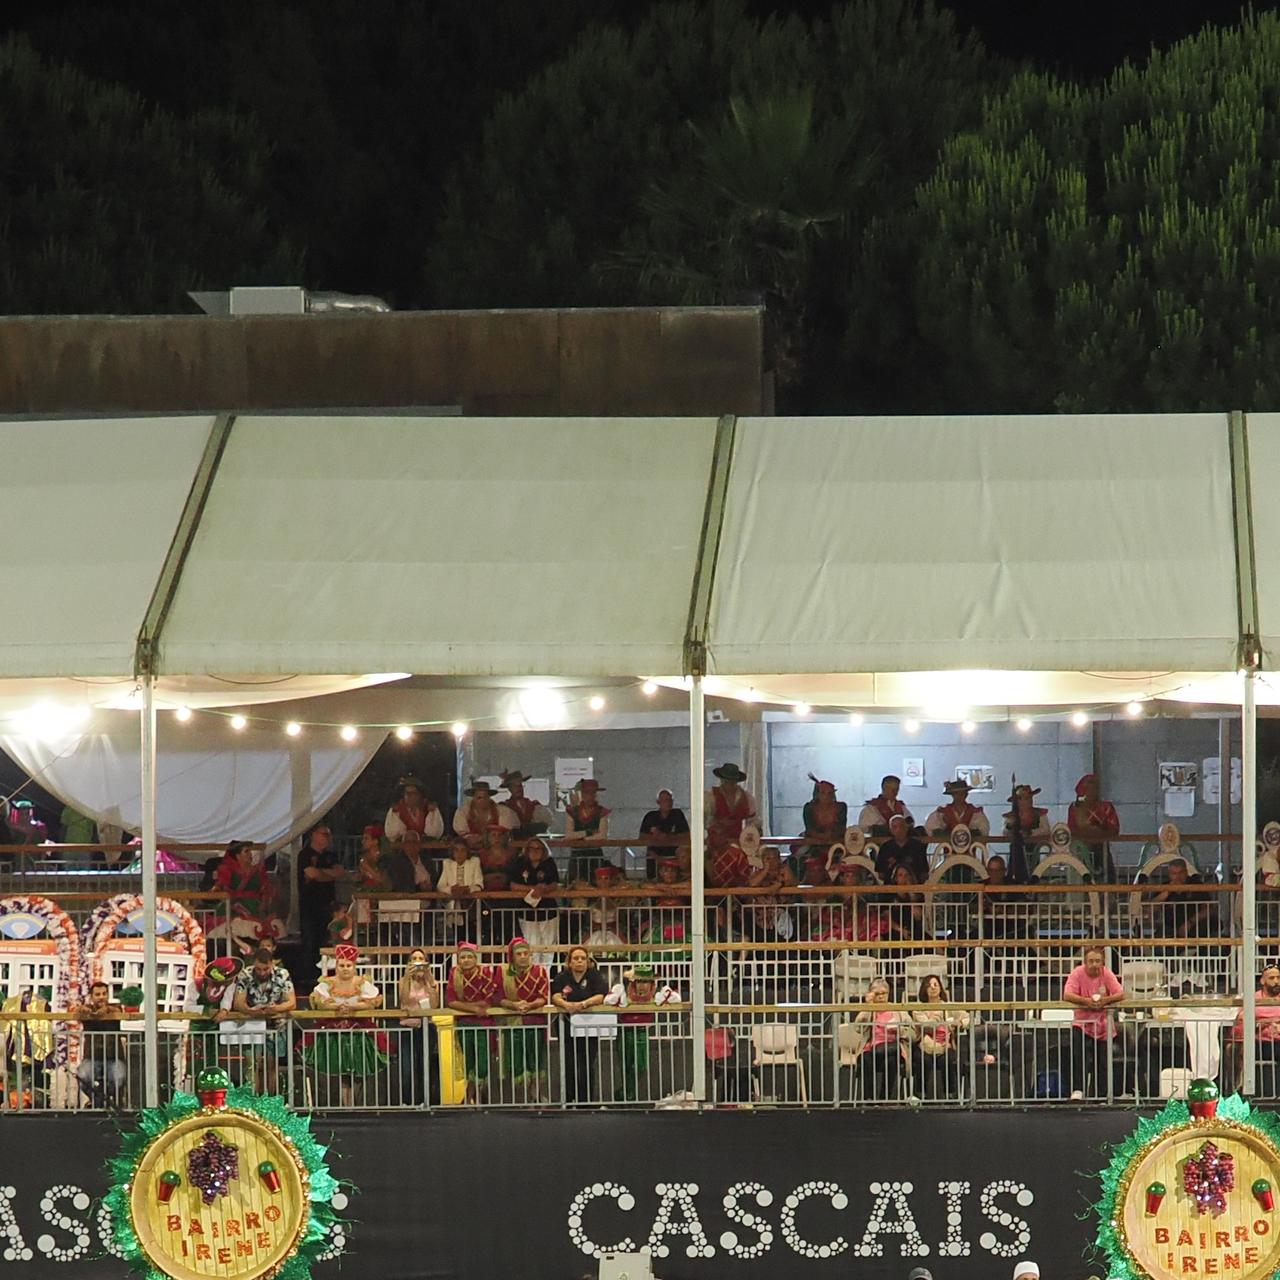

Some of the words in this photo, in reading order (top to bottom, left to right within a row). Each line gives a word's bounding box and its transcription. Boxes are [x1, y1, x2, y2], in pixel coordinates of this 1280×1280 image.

[166, 1205, 282, 1239] BAIRRO
[567, 1180, 1034, 1259] CASCAIS
[1154, 1219, 1270, 1250] BAIRRO
[181, 1231, 272, 1265] IRENE
[1166, 1247, 1259, 1275] IRENE
